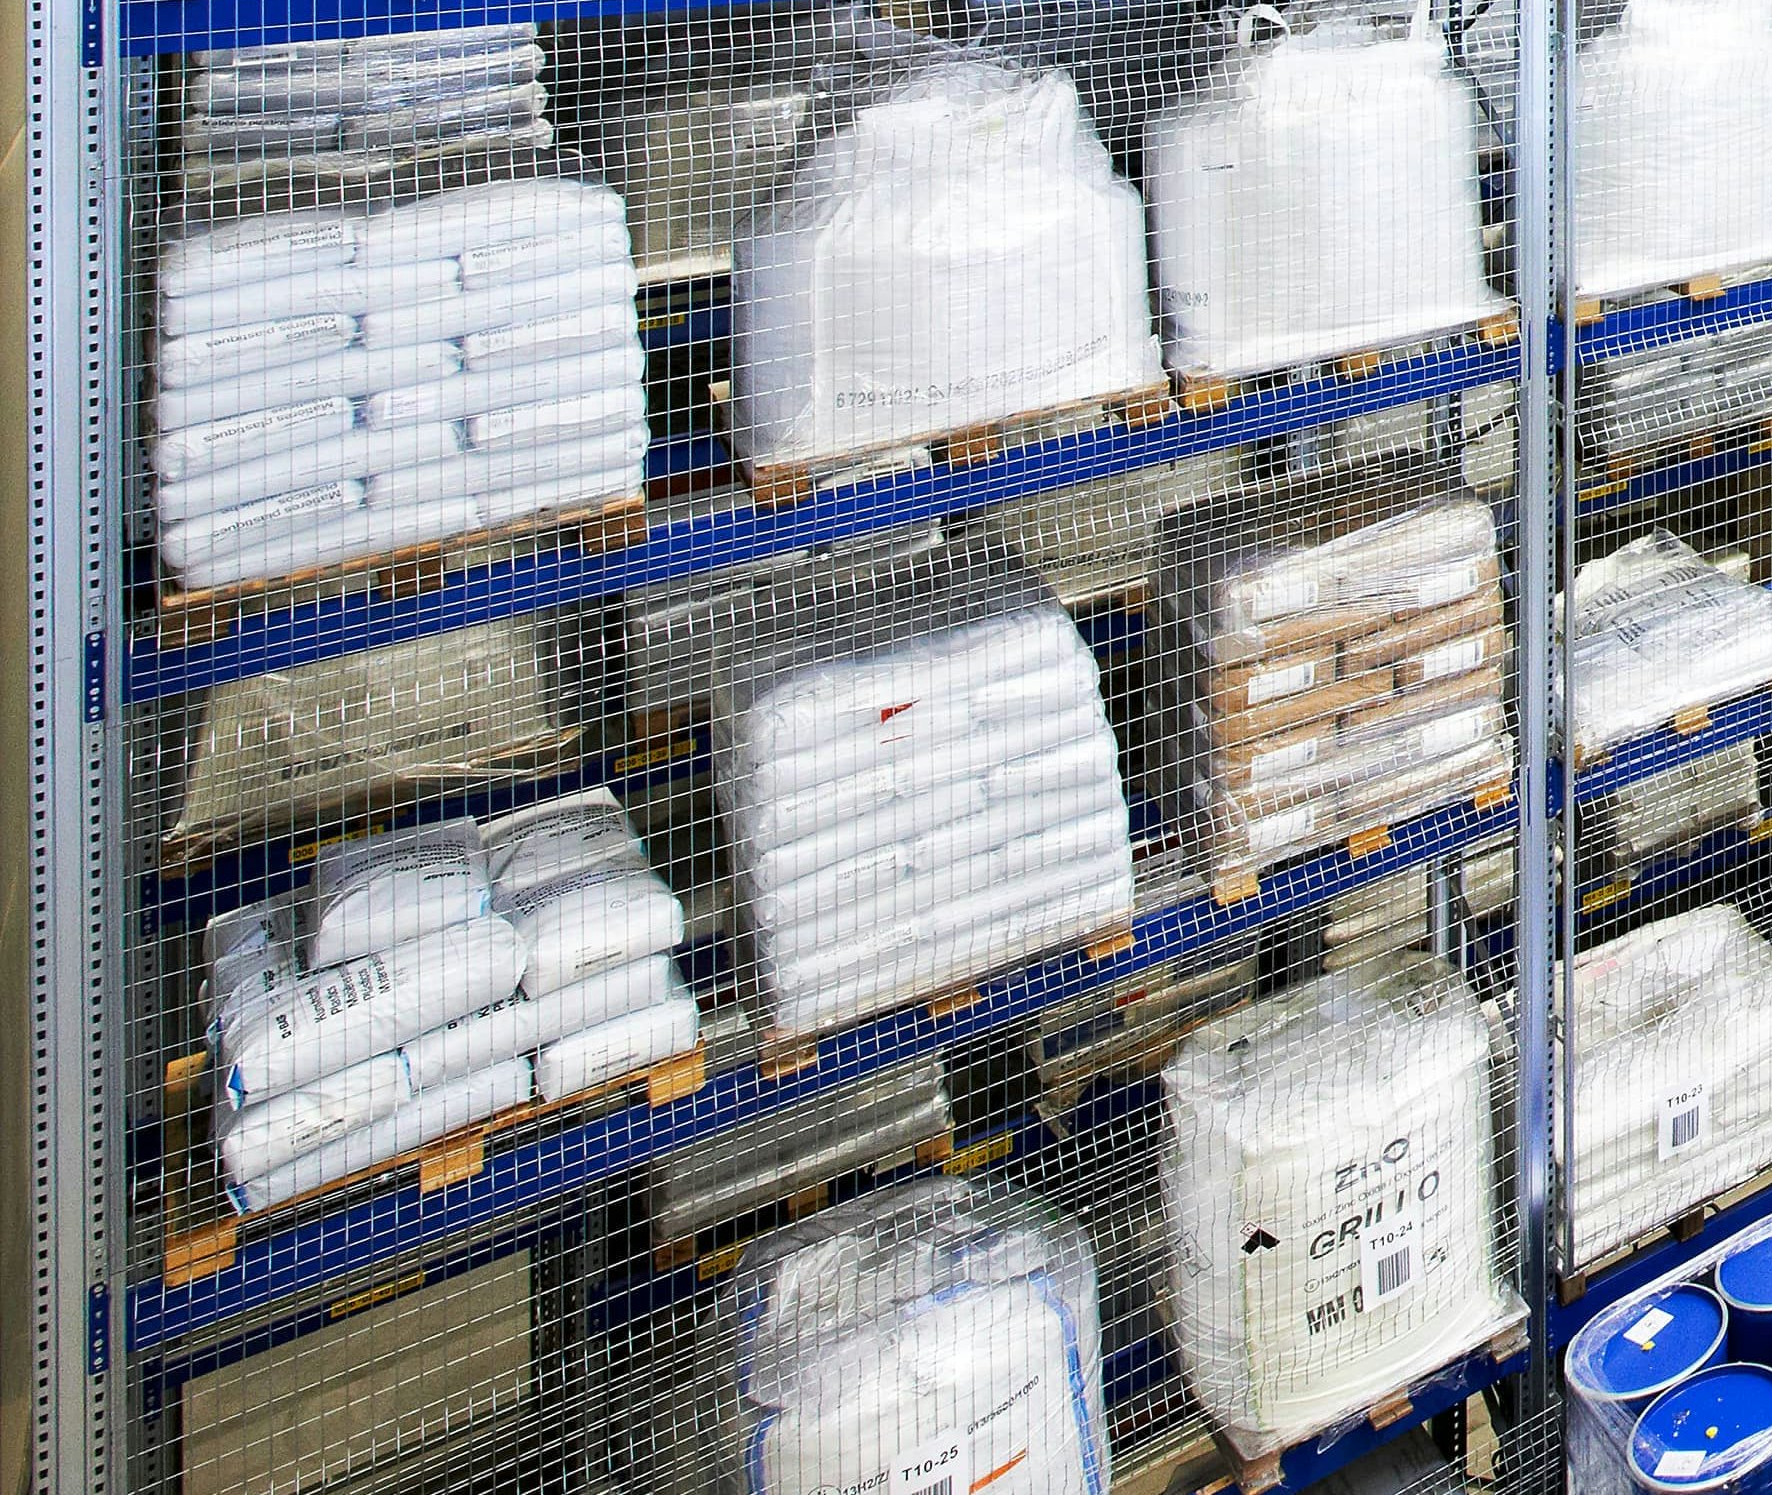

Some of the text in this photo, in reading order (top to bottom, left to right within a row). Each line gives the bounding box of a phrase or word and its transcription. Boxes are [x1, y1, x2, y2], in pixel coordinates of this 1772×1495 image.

[1667, 1083, 1703, 1108] T10-23
[1334, 1137, 1410, 1194] ZnO
[1369, 1220, 1414, 1251] T10-24
[1306, 1294, 1346, 1336] MM
[901, 1444, 959, 1482] T10-25
